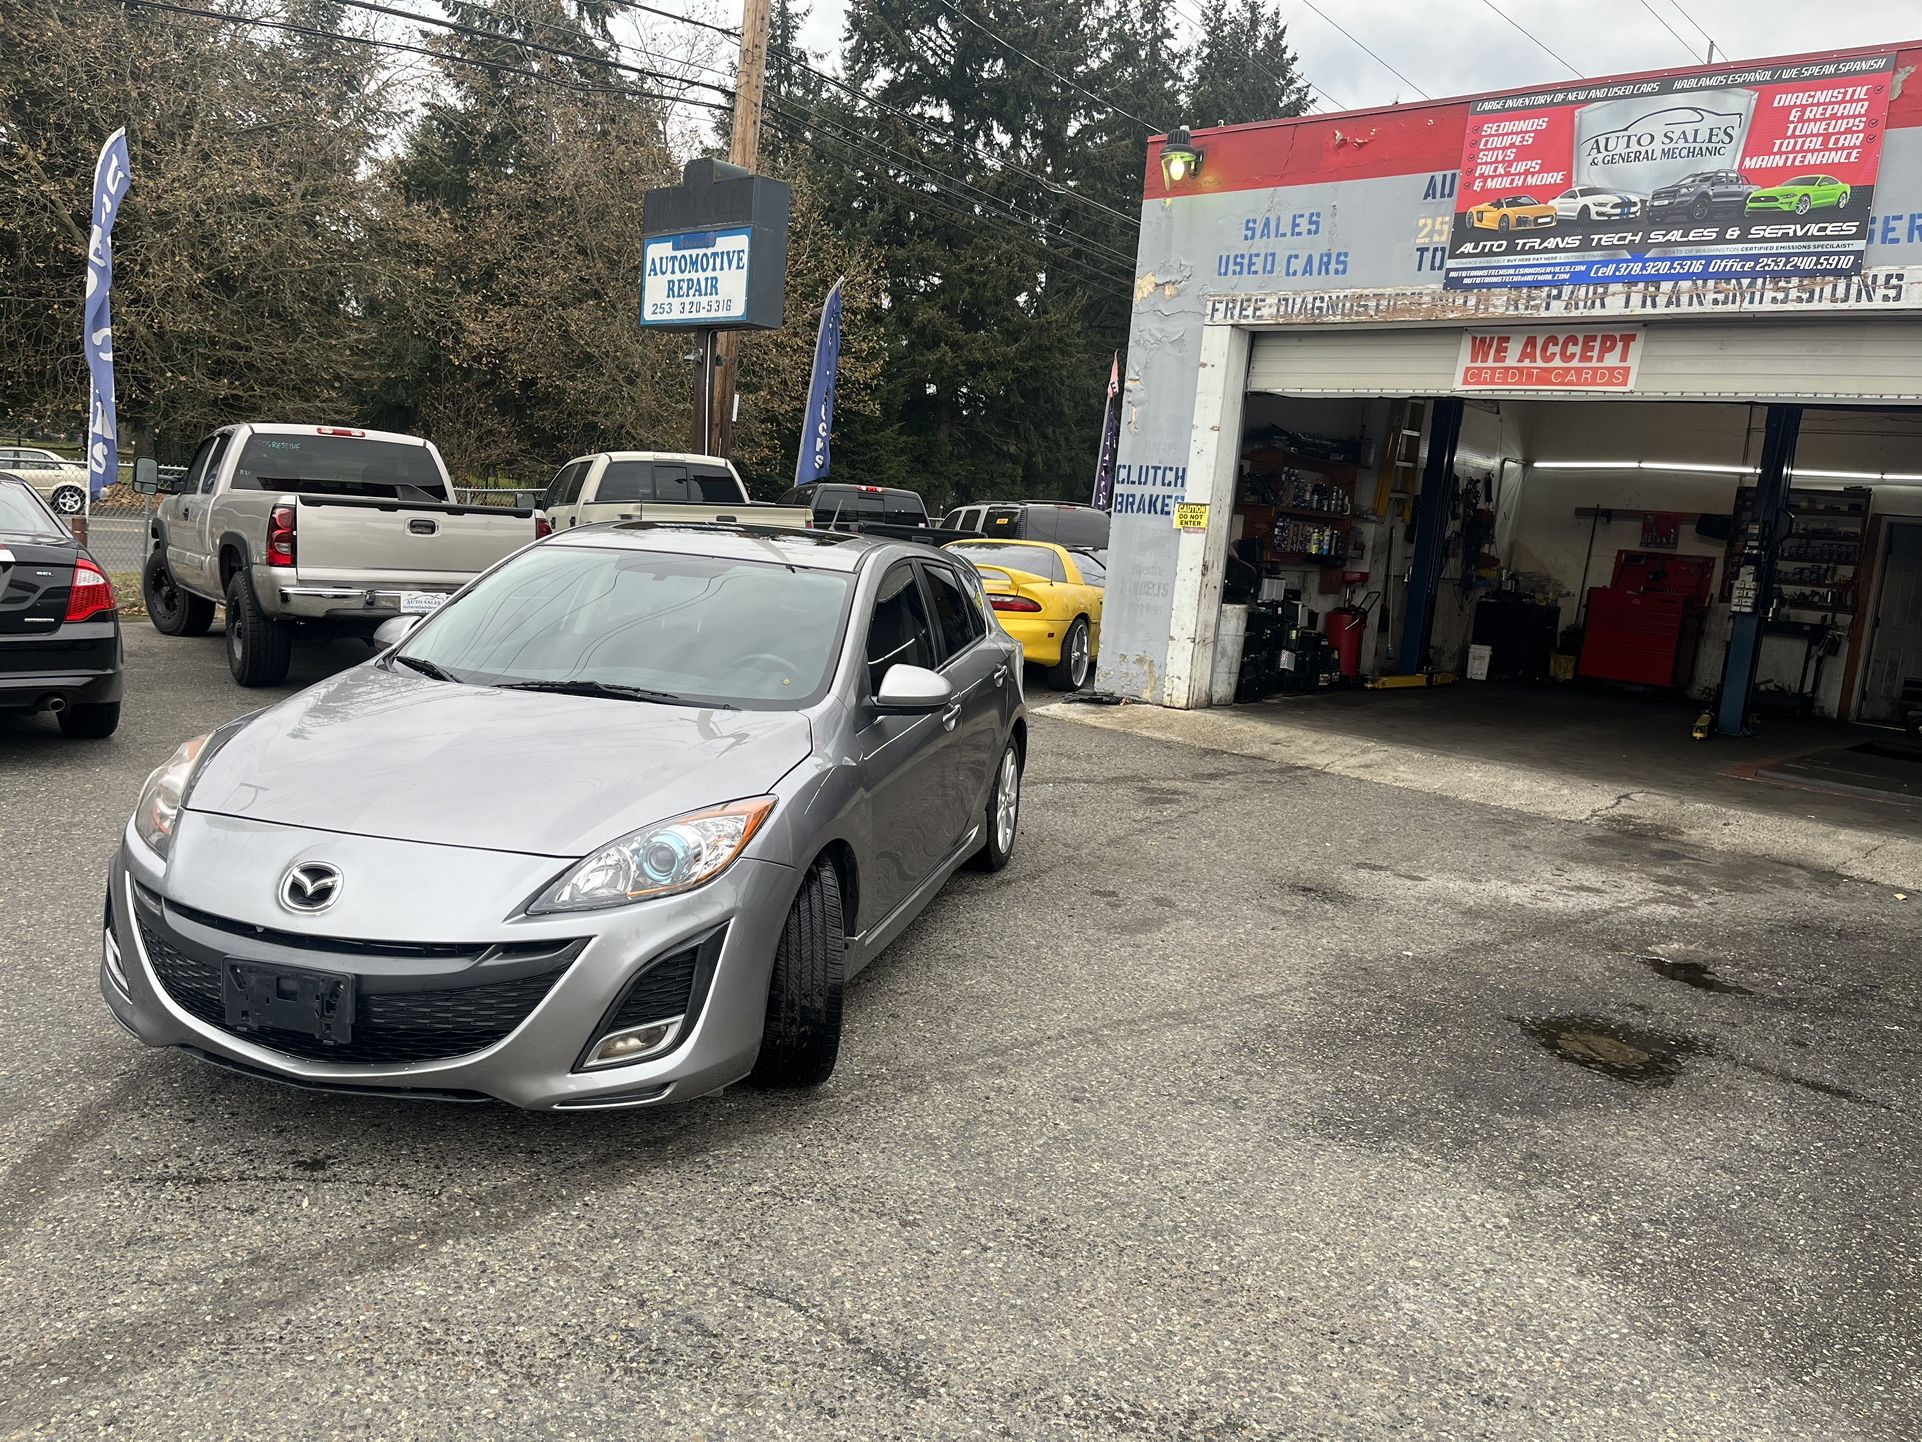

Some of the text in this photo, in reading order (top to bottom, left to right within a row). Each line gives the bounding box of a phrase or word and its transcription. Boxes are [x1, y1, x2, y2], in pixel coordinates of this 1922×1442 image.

[1476, 99, 1506, 112] LARGE
[1504, 93, 1552, 109] INVENTORY
[1554, 91, 1567, 103] OF
[1566, 89, 1587, 102] NEW
[1589, 87, 1607, 100] AND
[1607, 84, 1635, 98] USED
[1633, 82, 1661, 95] CARS
[1672, 75, 1727, 90] HABLAMOS
[1727, 69, 1773, 85] ESPAÑOL
[1781, 67, 1802, 79] WE
[1799, 64, 1837, 78] SPEAK
[1837, 58, 1888, 74] SPANISH
[1772, 84, 1873, 108] DIAGNISTIC
[1803, 101, 1869, 121] REPAIR
[1786, 117, 1867, 137] TUNEUPS
[1479, 133, 1535, 150] COUPES
[1586, 125, 1736, 158] AUTO SALES
[1772, 133, 1865, 153] TOTAL CAR
[1477, 148, 1517, 163] SUVS
[1589, 146, 1726, 167] & GENERAL MECHANIC
[1742, 149, 1863, 170] MAINTENANCE
[1475, 159, 1542, 177] PICK-UPS
[1484, 175, 1525, 190] MUCH
[1525, 171, 1567, 186] MORE
[1243, 211, 1322, 241] SALES
[1455, 221, 1860, 255] AUTO TRANS TECH SALES & SERVICES
[647, 249, 745, 277] AUTOMOTIVE
[1217, 251, 1349, 277] USED CARS
[1590, 255, 1854, 277] Cell 378.320.5316 Office 253.240.5910
[666, 276, 719, 299] REPAIR
[651, 298, 732, 315] 253 320-5316
[1210, 297, 1267, 321] FREE
[1470, 333, 1637, 364] WE ACCEPT
[1467, 369, 1625, 383] CREDIT CARDS
[1115, 464, 1186, 488] CLUTCH
[1178, 504, 1207, 513] CAUTION
